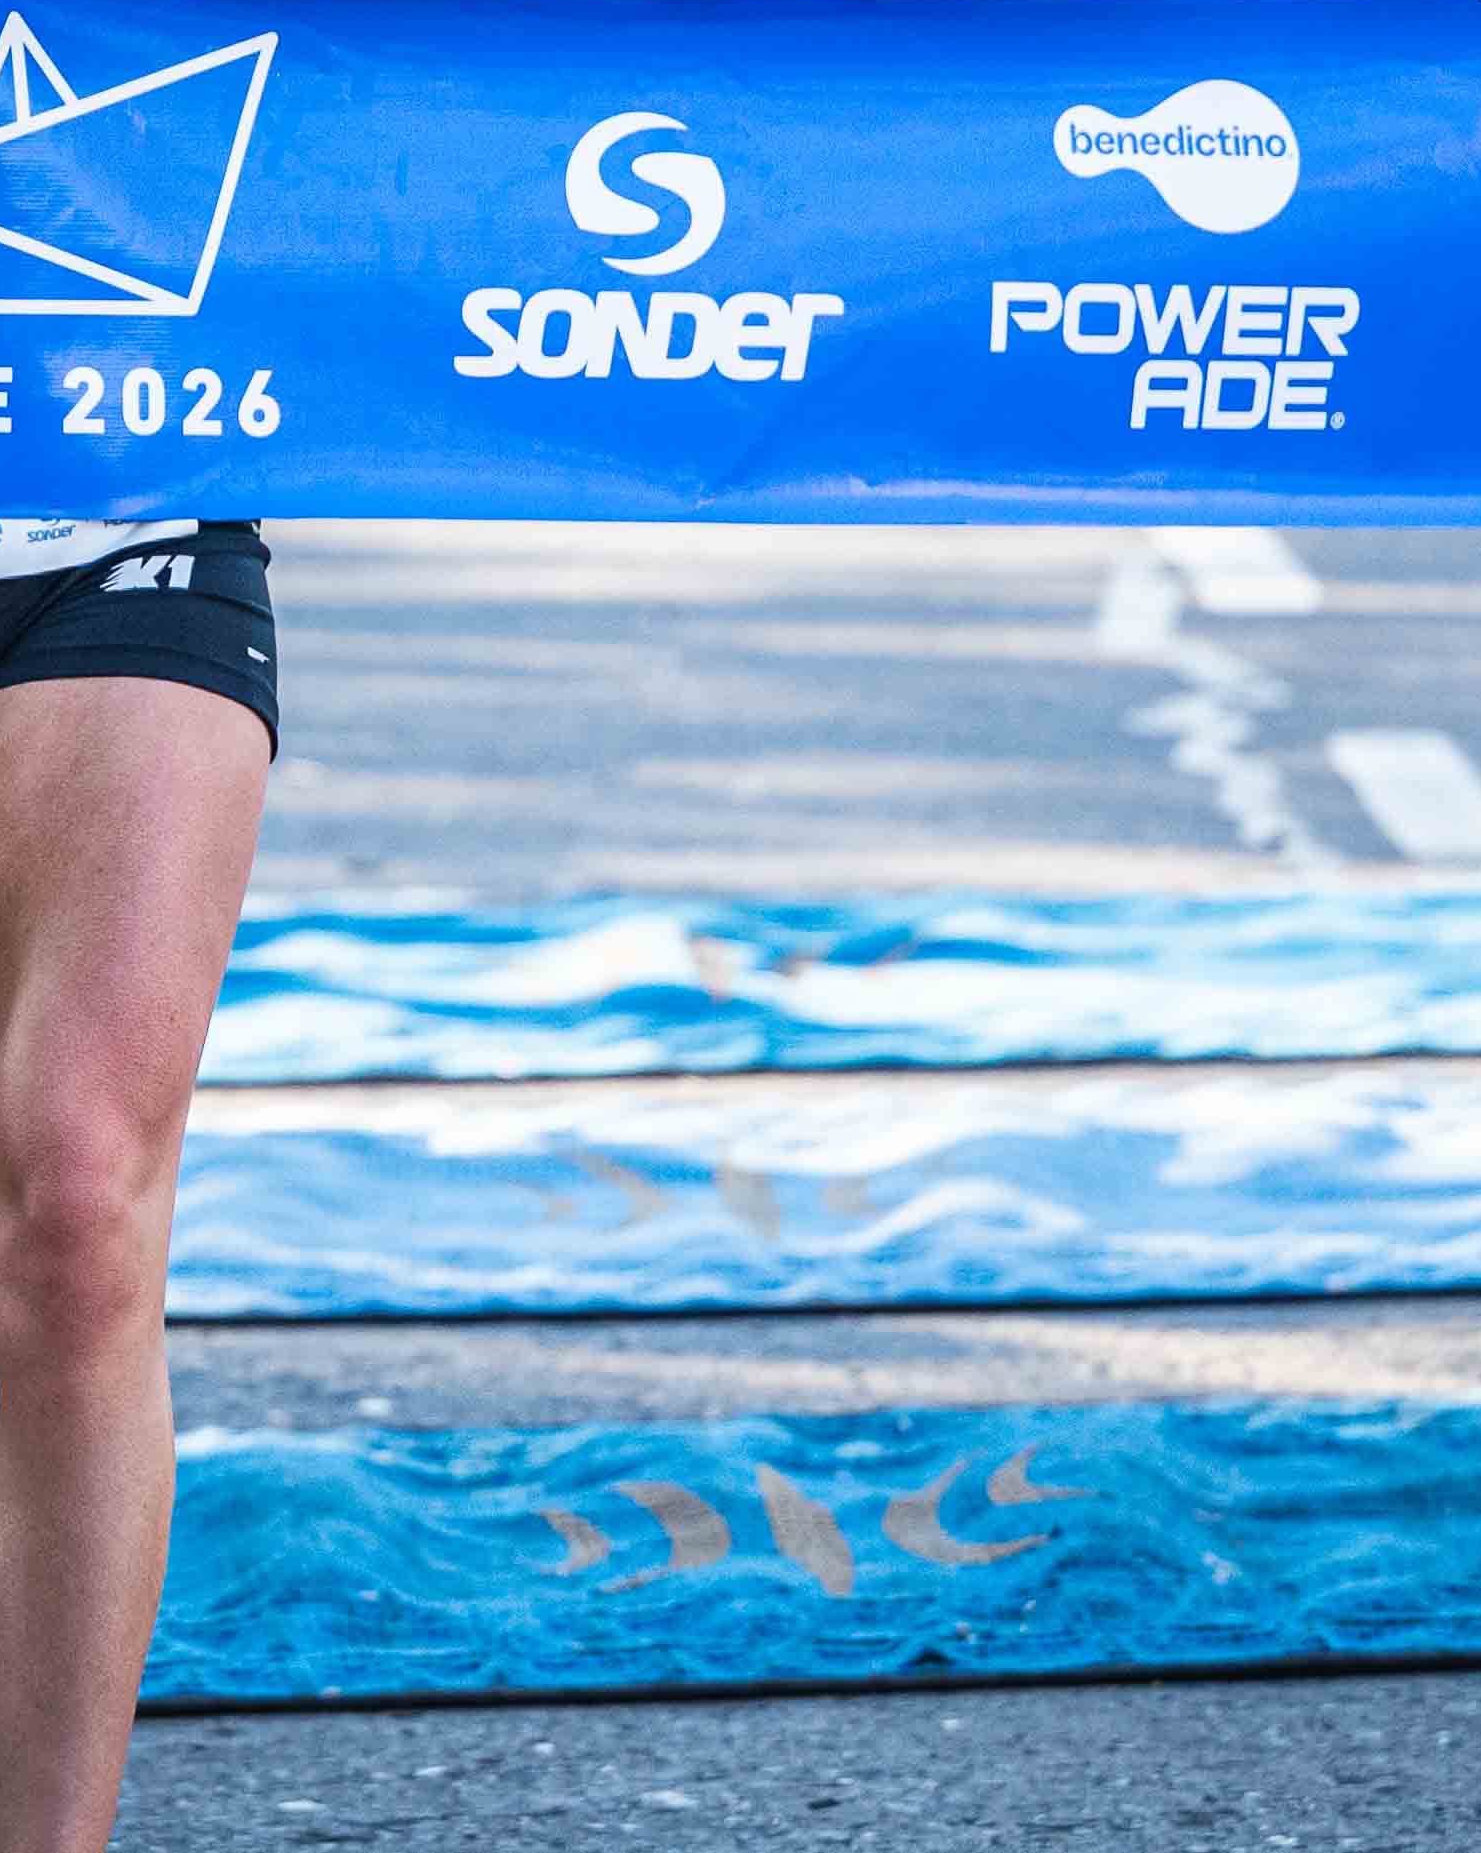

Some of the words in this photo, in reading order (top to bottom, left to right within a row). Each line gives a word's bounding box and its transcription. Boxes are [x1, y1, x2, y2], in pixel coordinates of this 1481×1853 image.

[1070, 123, 1287, 158] benedictino
[989, 280, 1361, 357] POWER
[62, 365, 282, 438] 2026
